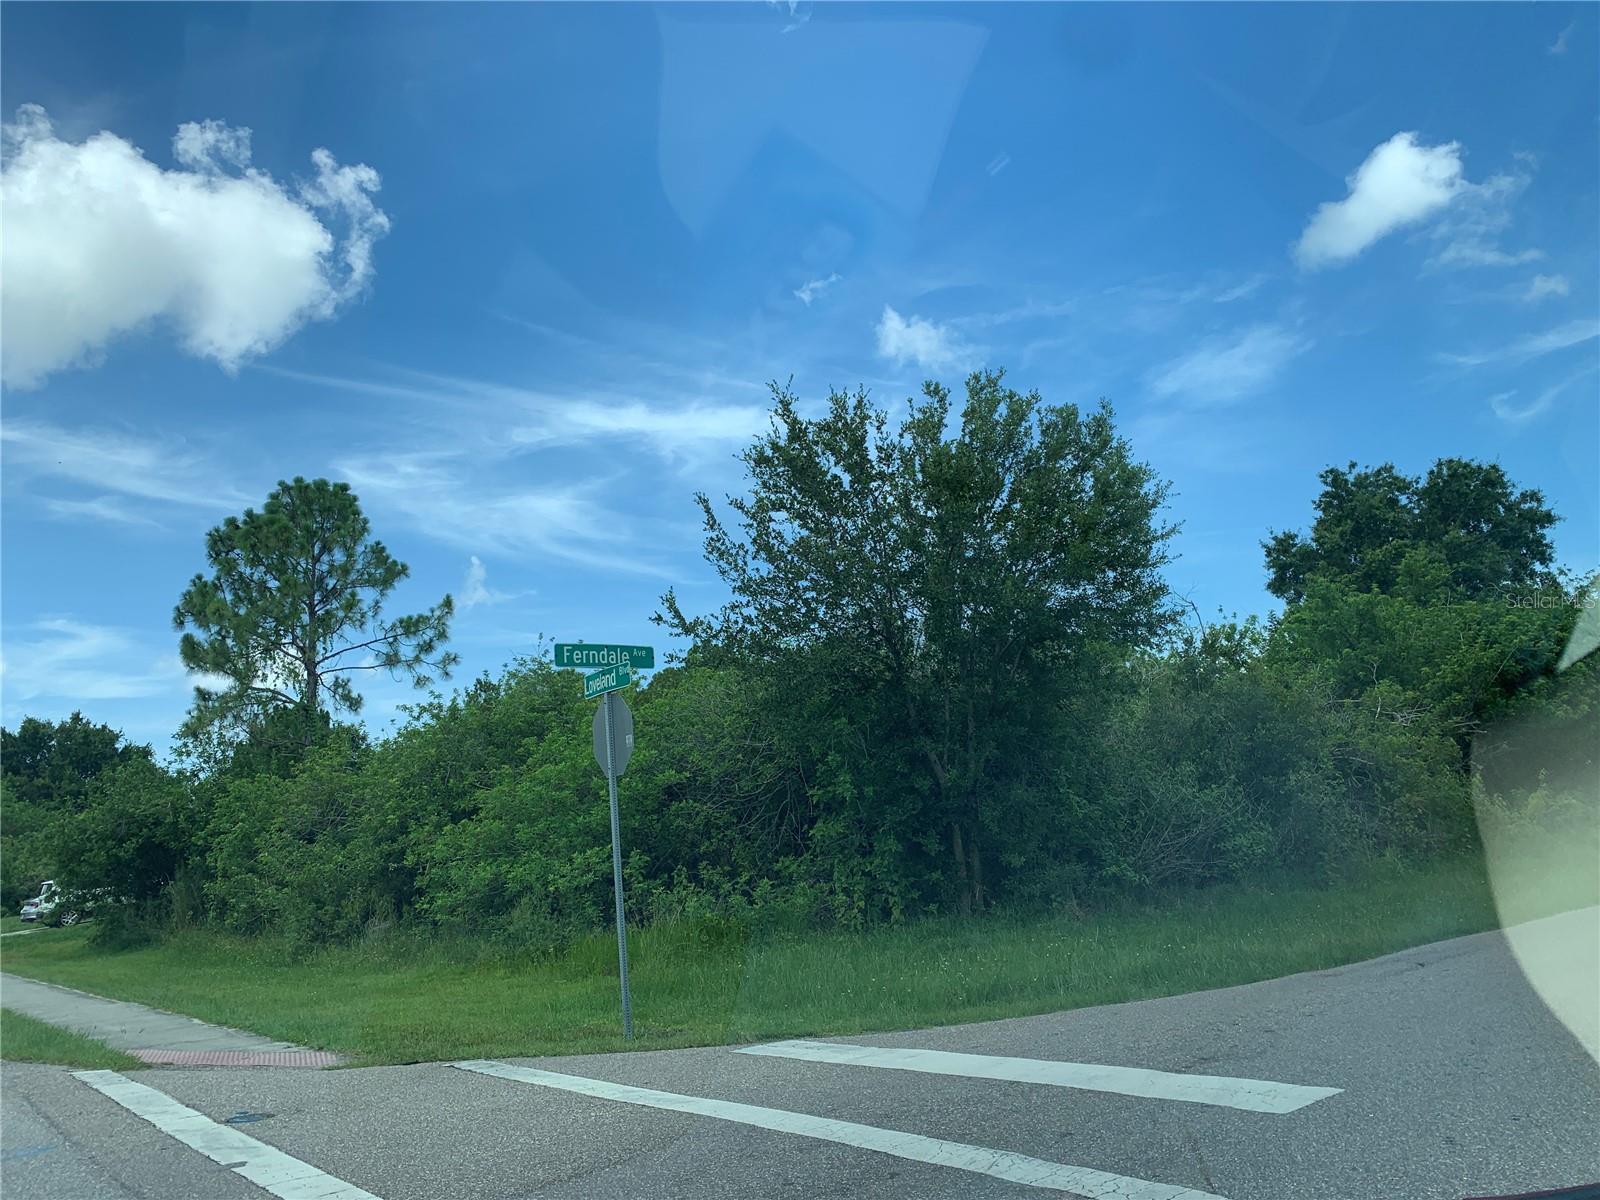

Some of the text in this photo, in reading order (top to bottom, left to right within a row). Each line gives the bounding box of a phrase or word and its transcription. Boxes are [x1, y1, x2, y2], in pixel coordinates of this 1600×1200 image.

[563, 646, 646, 664] Ferndale Ave
[584, 669, 617, 695] Loveland
